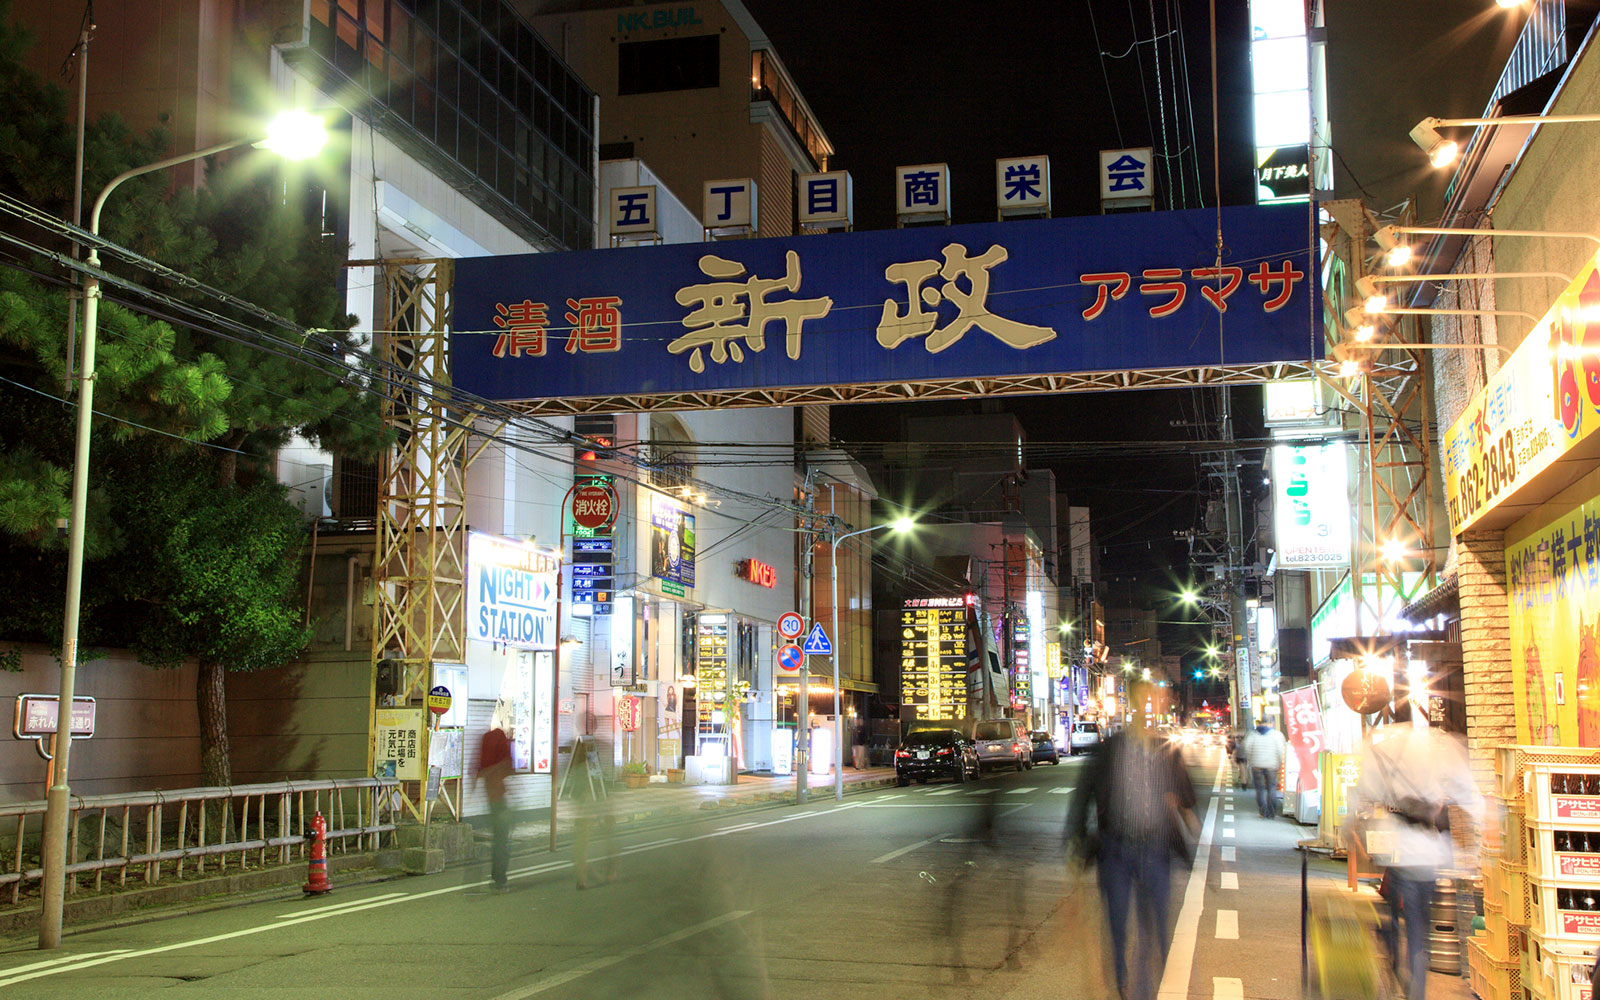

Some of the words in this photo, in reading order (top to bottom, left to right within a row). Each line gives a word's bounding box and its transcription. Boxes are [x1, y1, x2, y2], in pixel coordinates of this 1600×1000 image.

[1260, 164, 1309, 182] 月下美人
[492, 295, 623, 359] 清酒
[667, 243, 1058, 374] 新政
[1080, 260, 1305, 322] アラマサ
[575, 499, 608, 516] 消火栓
[480, 564, 533, 605] NIGHT
[783, 619, 799, 632] 30
[387, 729, 397, 758] 元気に
[397, 729, 407, 768] 町工場を
[407, 729, 417, 758] 商店街
